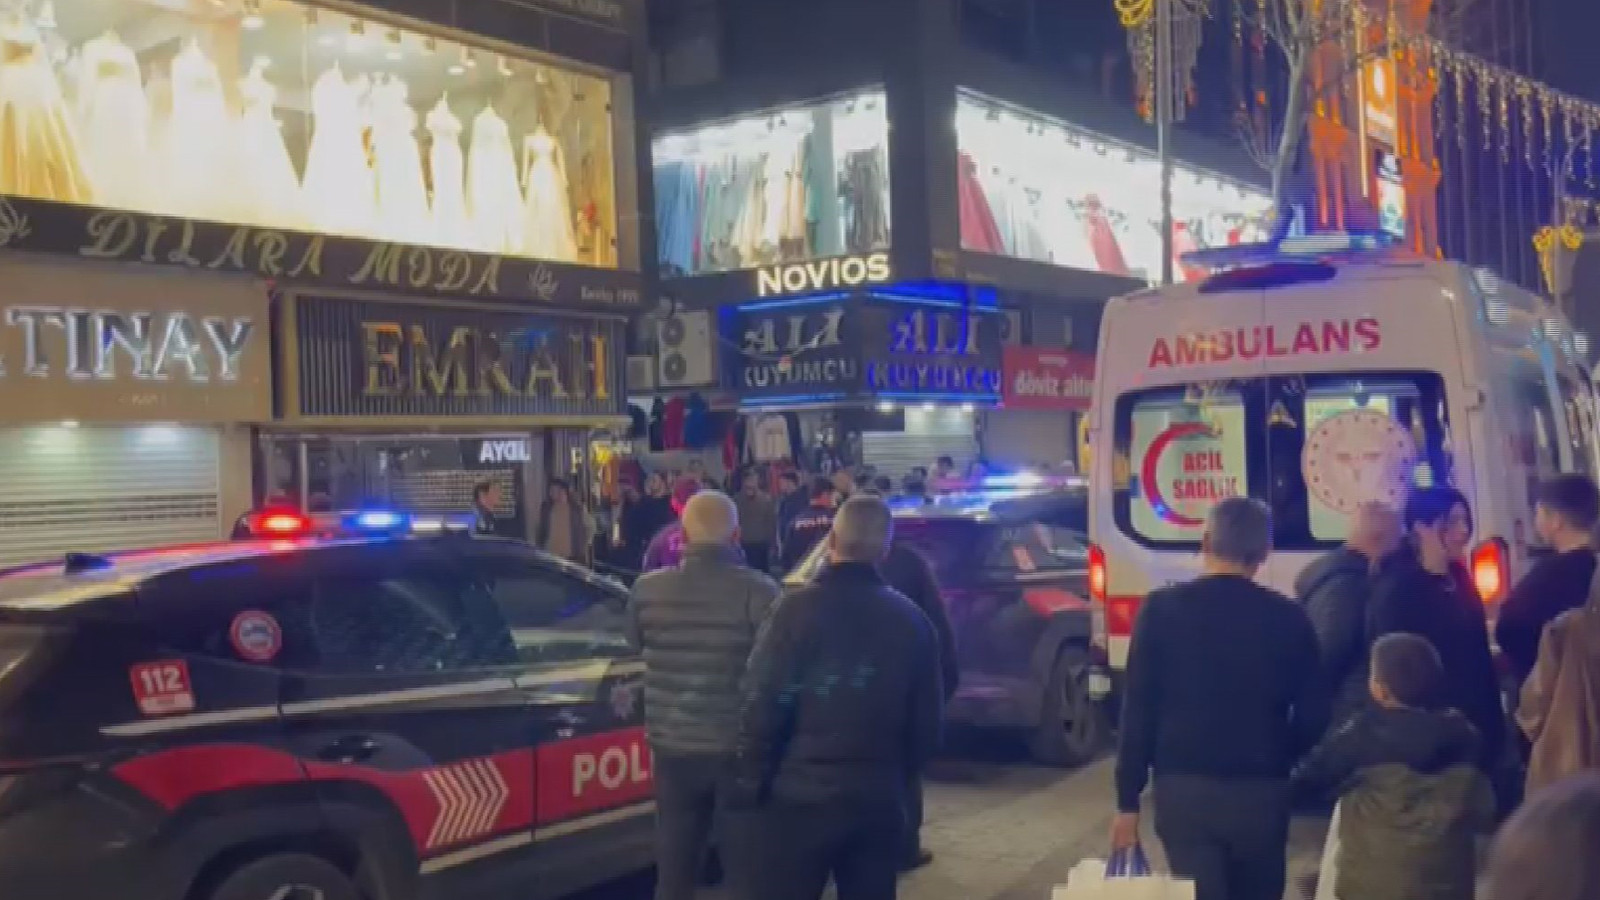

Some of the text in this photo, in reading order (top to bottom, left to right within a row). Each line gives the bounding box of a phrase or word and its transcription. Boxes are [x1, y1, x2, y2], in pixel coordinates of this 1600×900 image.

[350, 241, 499, 294] MODA
[757, 253, 890, 297] NOVIOS
[0, 304, 255, 381] TINAY
[1148, 318, 1382, 369] AMBULANS
[140, 667, 183, 694] 112
[572, 740, 653, 797] POL
